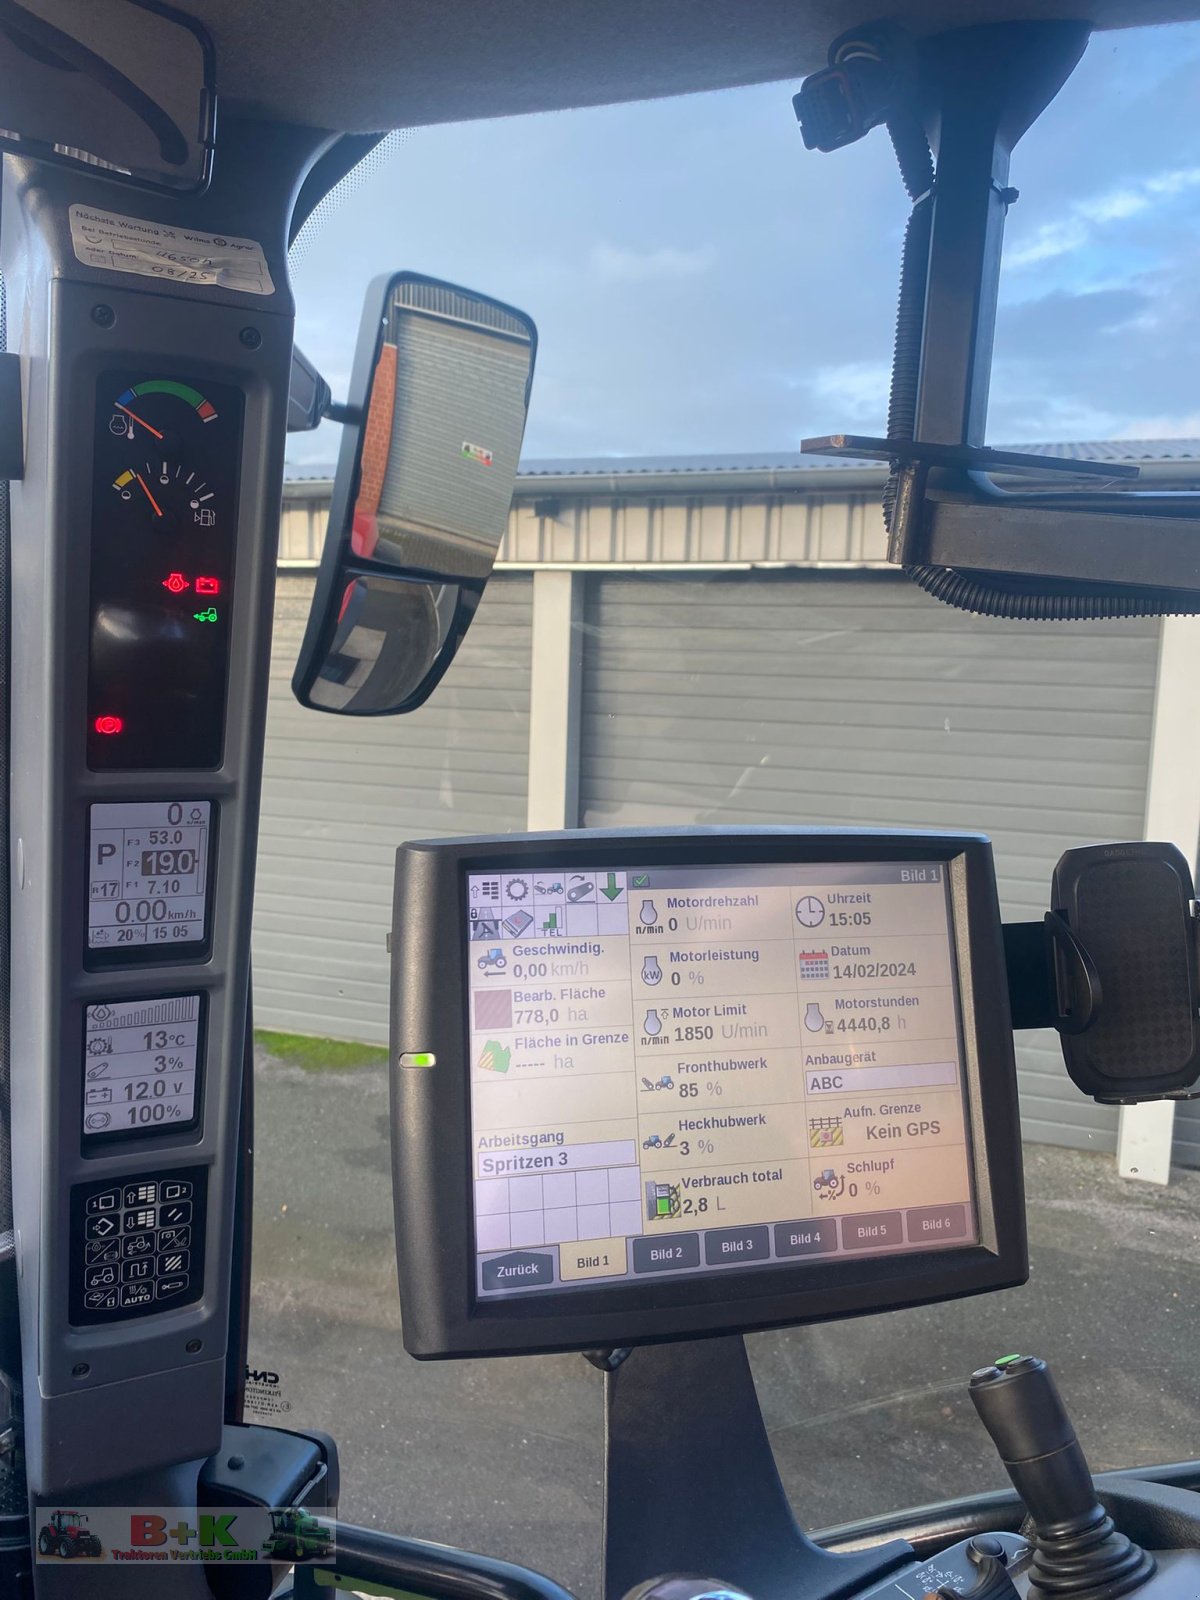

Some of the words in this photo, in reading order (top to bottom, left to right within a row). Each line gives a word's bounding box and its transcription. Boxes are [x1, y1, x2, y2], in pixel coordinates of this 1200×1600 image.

[75, 210, 115, 226] Nächste
[119, 221, 160, 237] Wartung
[168, 803, 182, 826] 0
[149, 830, 183, 845] 53.0
[97, 843, 116, 865] P
[146, 850, 193, 875] 19.0
[901, 869, 926, 882] Bild
[930, 869, 938, 881] 1
[147, 879, 180, 895] 7.10
[667, 895, 759, 909] Motordrehzahl
[827, 892, 871, 904] Uhrzeit
[115, 899, 167, 923] 0.00
[168, 909, 196, 919] km/h
[829, 911, 872, 926] 15:05
[668, 917, 678, 931] 0
[686, 916, 732, 931] U/min
[512, 942, 604, 957] Geschwindig.
[670, 949, 760, 963] Motorleistung
[831, 945, 871, 957] Datum
[513, 963, 547, 981] 0,00
[551, 959, 589, 977] km/h
[833, 962, 916, 979] 14/02/2024
[671, 971, 681, 986] 0
[514, 989, 556, 1003] Bearb.
[560, 986, 606, 1000] Fläche
[835, 995, 919, 1010] Motorstunden
[514, 1007, 559, 1026] 778,0
[568, 1007, 589, 1022] ha
[673, 1006, 711, 1019] Motor
[714, 1003, 747, 1017] Limit
[674, 1025, 714, 1042] 1850
[721, 1021, 768, 1039] U/min
[837, 1016, 890, 1033] 4440,8
[515, 1035, 561, 1049] Fläche
[566, 1034, 578, 1046] in
[582, 1032, 629, 1045] Grenze
[554, 1054, 574, 1069] ha
[677, 1056, 768, 1075] Fronthubwerk
[805, 1051, 877, 1066] Anbaugerät
[173, 1082, 183, 1094] V
[679, 1082, 699, 1098] 85
[810, 1075, 844, 1091] ABC
[843, 1105, 876, 1119] Aufn.
[879, 1102, 922, 1115] Grenze
[678, 1113, 767, 1131] Heckhubwerk
[866, 1123, 902, 1141] Kein
[906, 1120, 941, 1137] GPS
[478, 1131, 565, 1149] Arbeitsgang
[679, 1140, 690, 1156] 3
[482, 1154, 553, 1175] Spritzen
[558, 1151, 568, 1166] 3
[847, 1157, 895, 1174] Schlupf
[682, 1171, 749, 1189] Verbrauch
[752, 1168, 783, 1183] total
[848, 1182, 858, 1198] 0
[683, 1197, 708, 1216] 2,8
[857, 1226, 878, 1238] Bild
[880, 1225, 887, 1235] 5
[922, 1219, 942, 1230] Bild
[944, 1218, 951, 1228] 6
[721, 1240, 744, 1253] Bild
[746, 1239, 753, 1250] 3
[790, 1233, 811, 1245] Bild
[814, 1232, 821, 1243] 4
[577, 1255, 600, 1269] Bild
[602, 1255, 609, 1266] 1
[650, 1249, 673, 1261] Bild
[676, 1247, 683, 1258] 2
[497, 1262, 539, 1278] Zurück
[124, 1294, 151, 1305] AUTO
